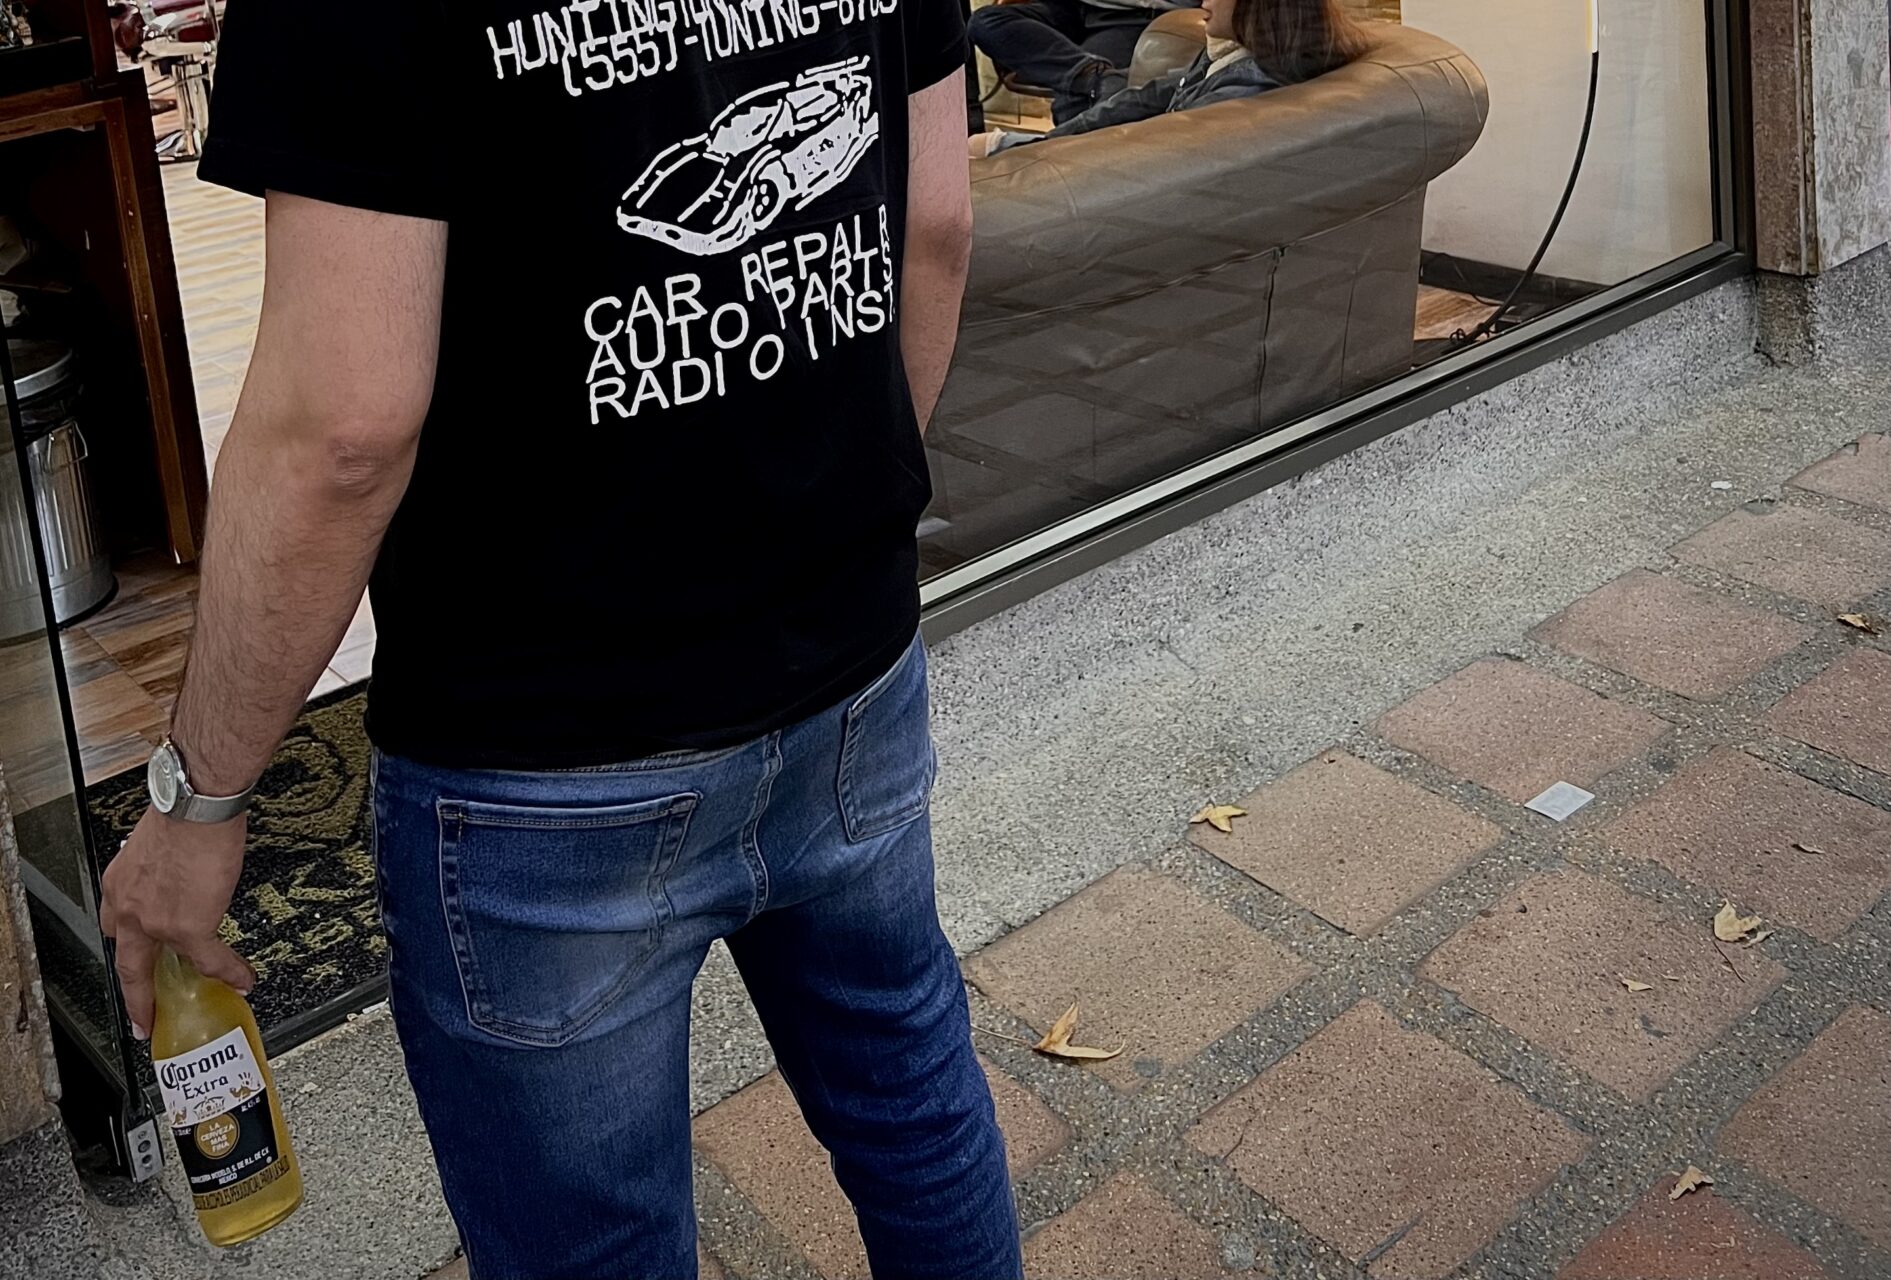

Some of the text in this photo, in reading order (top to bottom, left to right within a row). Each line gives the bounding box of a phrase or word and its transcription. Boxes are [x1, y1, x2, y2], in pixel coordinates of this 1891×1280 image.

[584, 273, 708, 342] CAR
[586, 302, 750, 384] AUTO
[590, 333, 785, 425] RADIO
[160, 1043, 239, 1091] Corona
[181, 1075, 229, 1100] Extra
[200, 1123, 235, 1142] CERVEZA
[209, 1122, 220, 1131] LA
